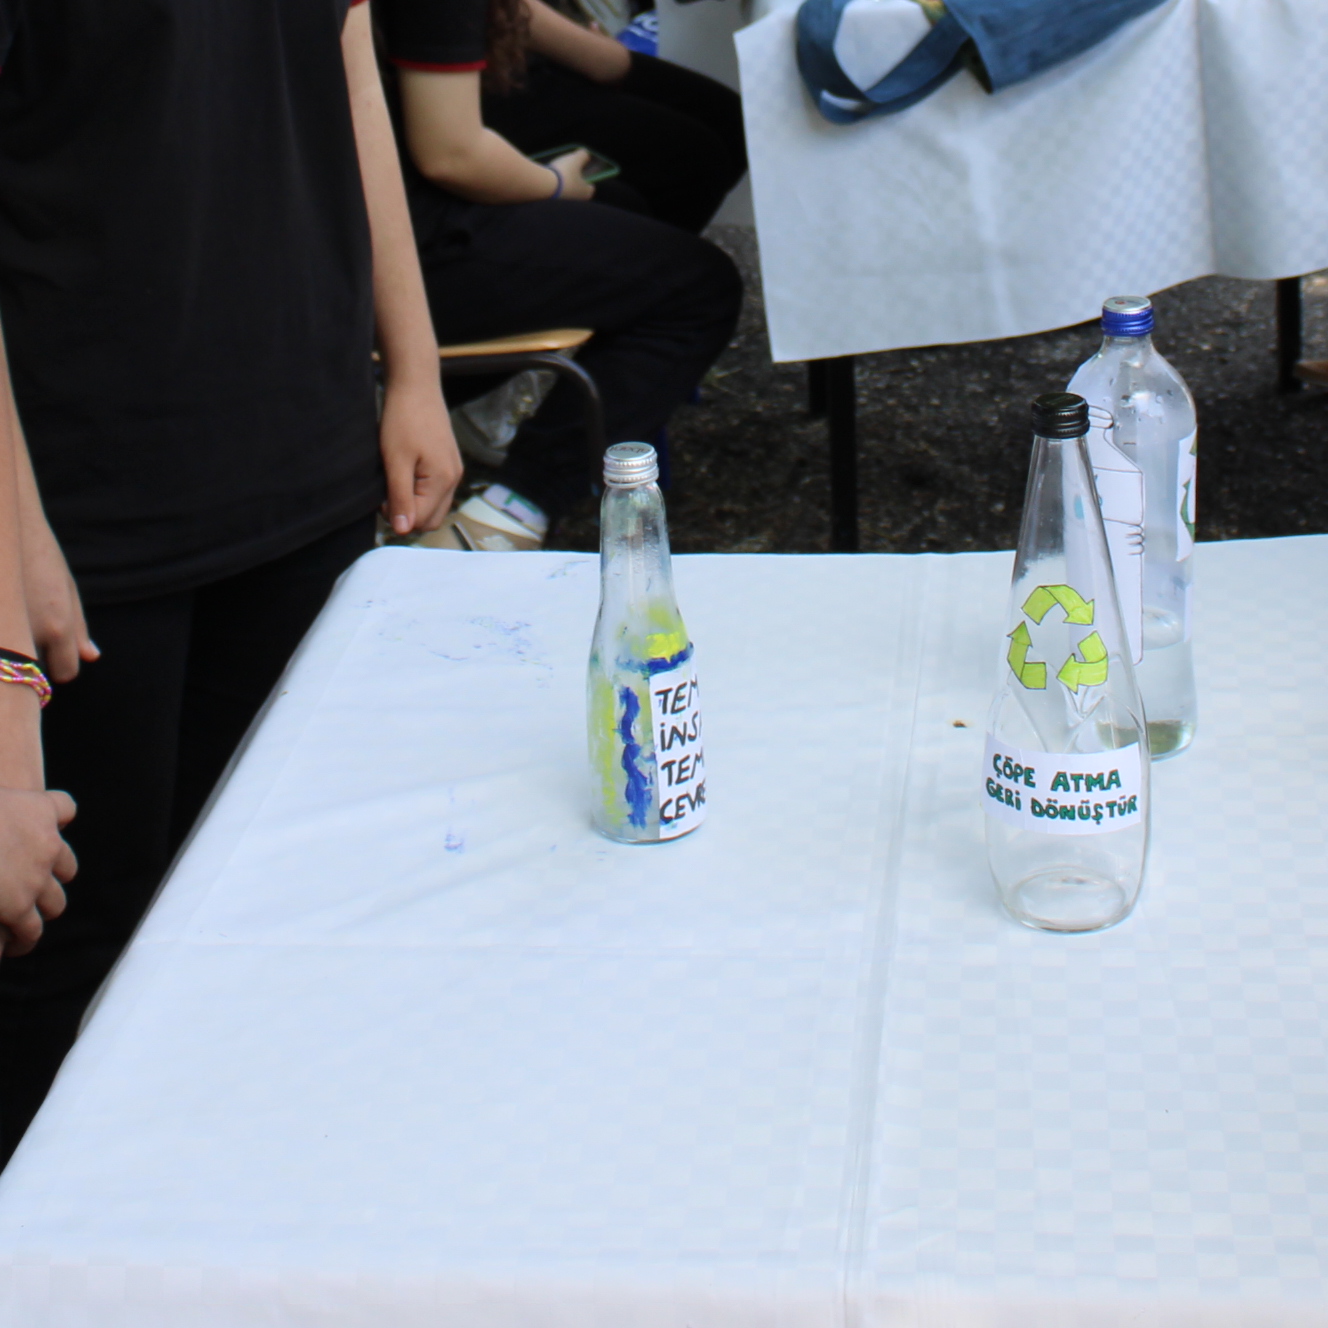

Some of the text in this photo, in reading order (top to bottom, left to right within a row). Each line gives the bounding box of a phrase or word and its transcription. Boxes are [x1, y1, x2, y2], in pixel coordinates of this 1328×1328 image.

[993, 753, 1121, 792] ÇÖPE ATMA
[986, 777, 1137, 825] GERİ DÖNÜŞTÜR
